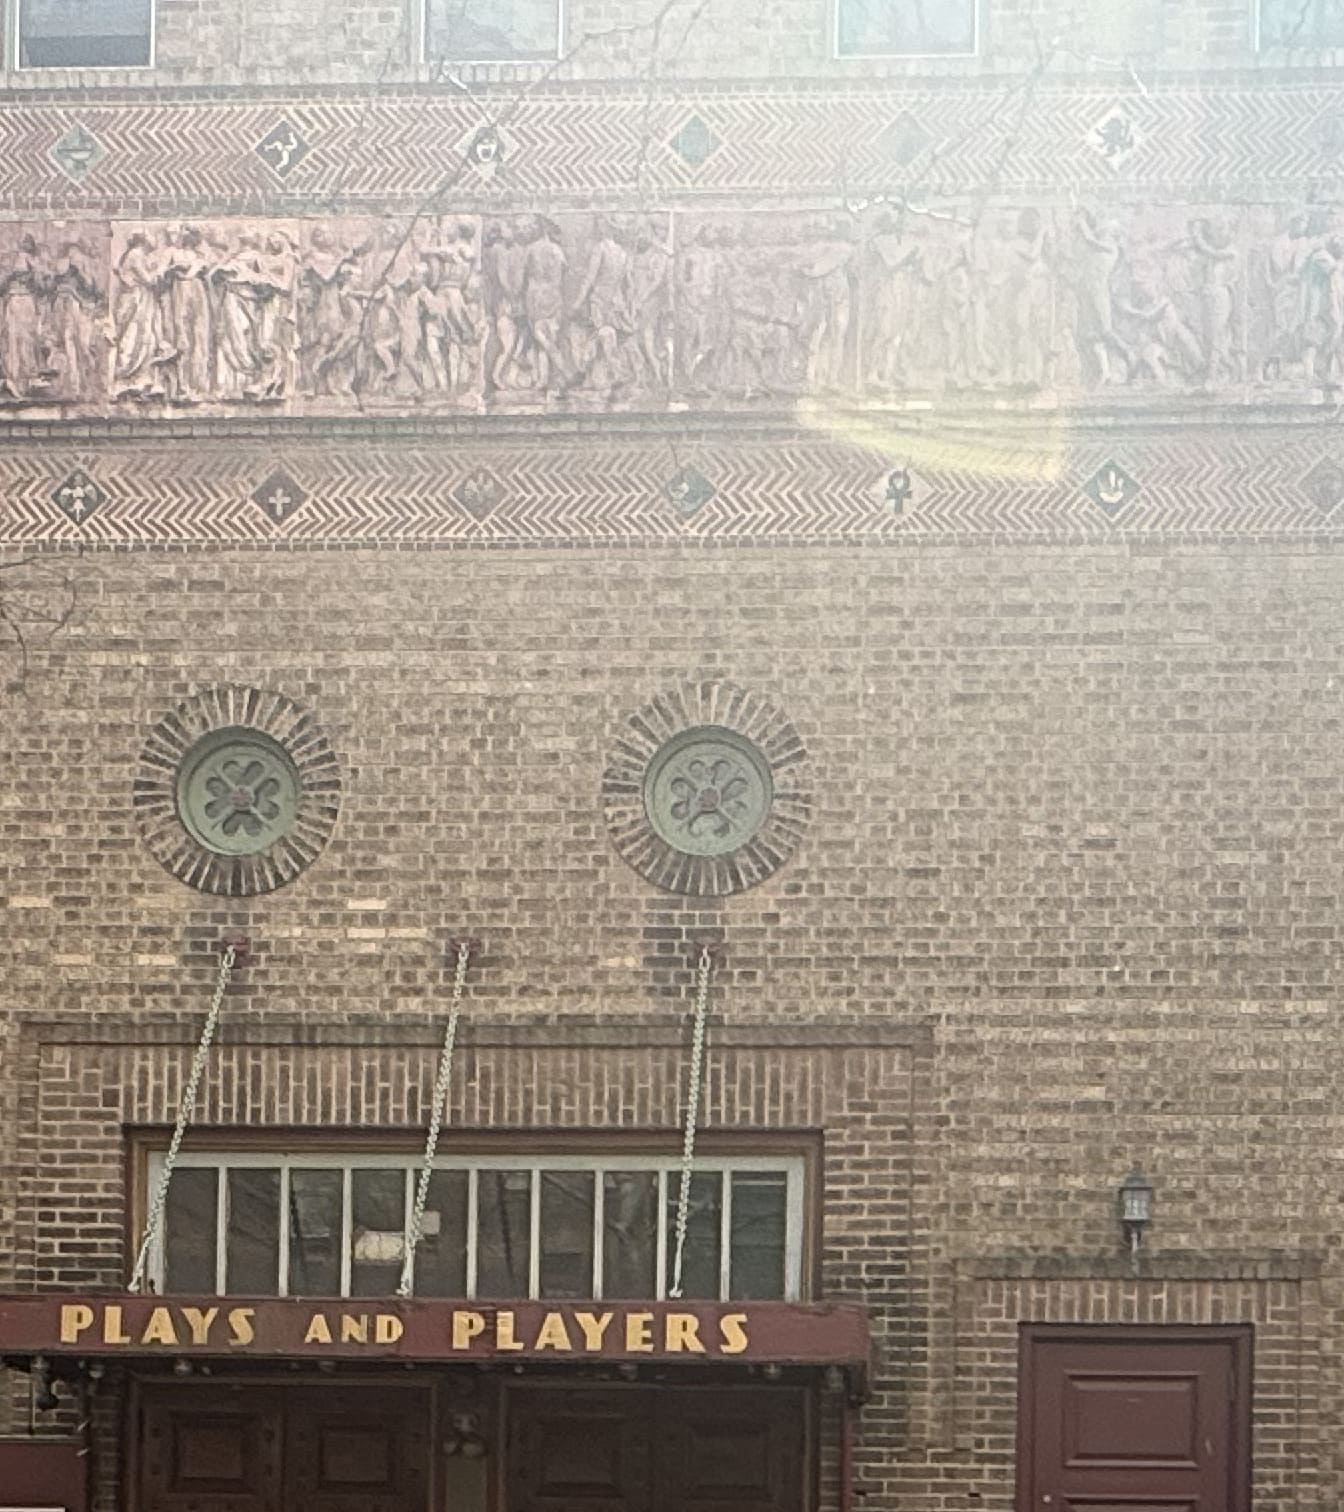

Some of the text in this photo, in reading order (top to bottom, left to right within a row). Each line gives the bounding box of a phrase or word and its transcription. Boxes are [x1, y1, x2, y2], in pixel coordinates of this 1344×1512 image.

[60, 1304, 749, 1353] PLAYS AND PLAYERS
